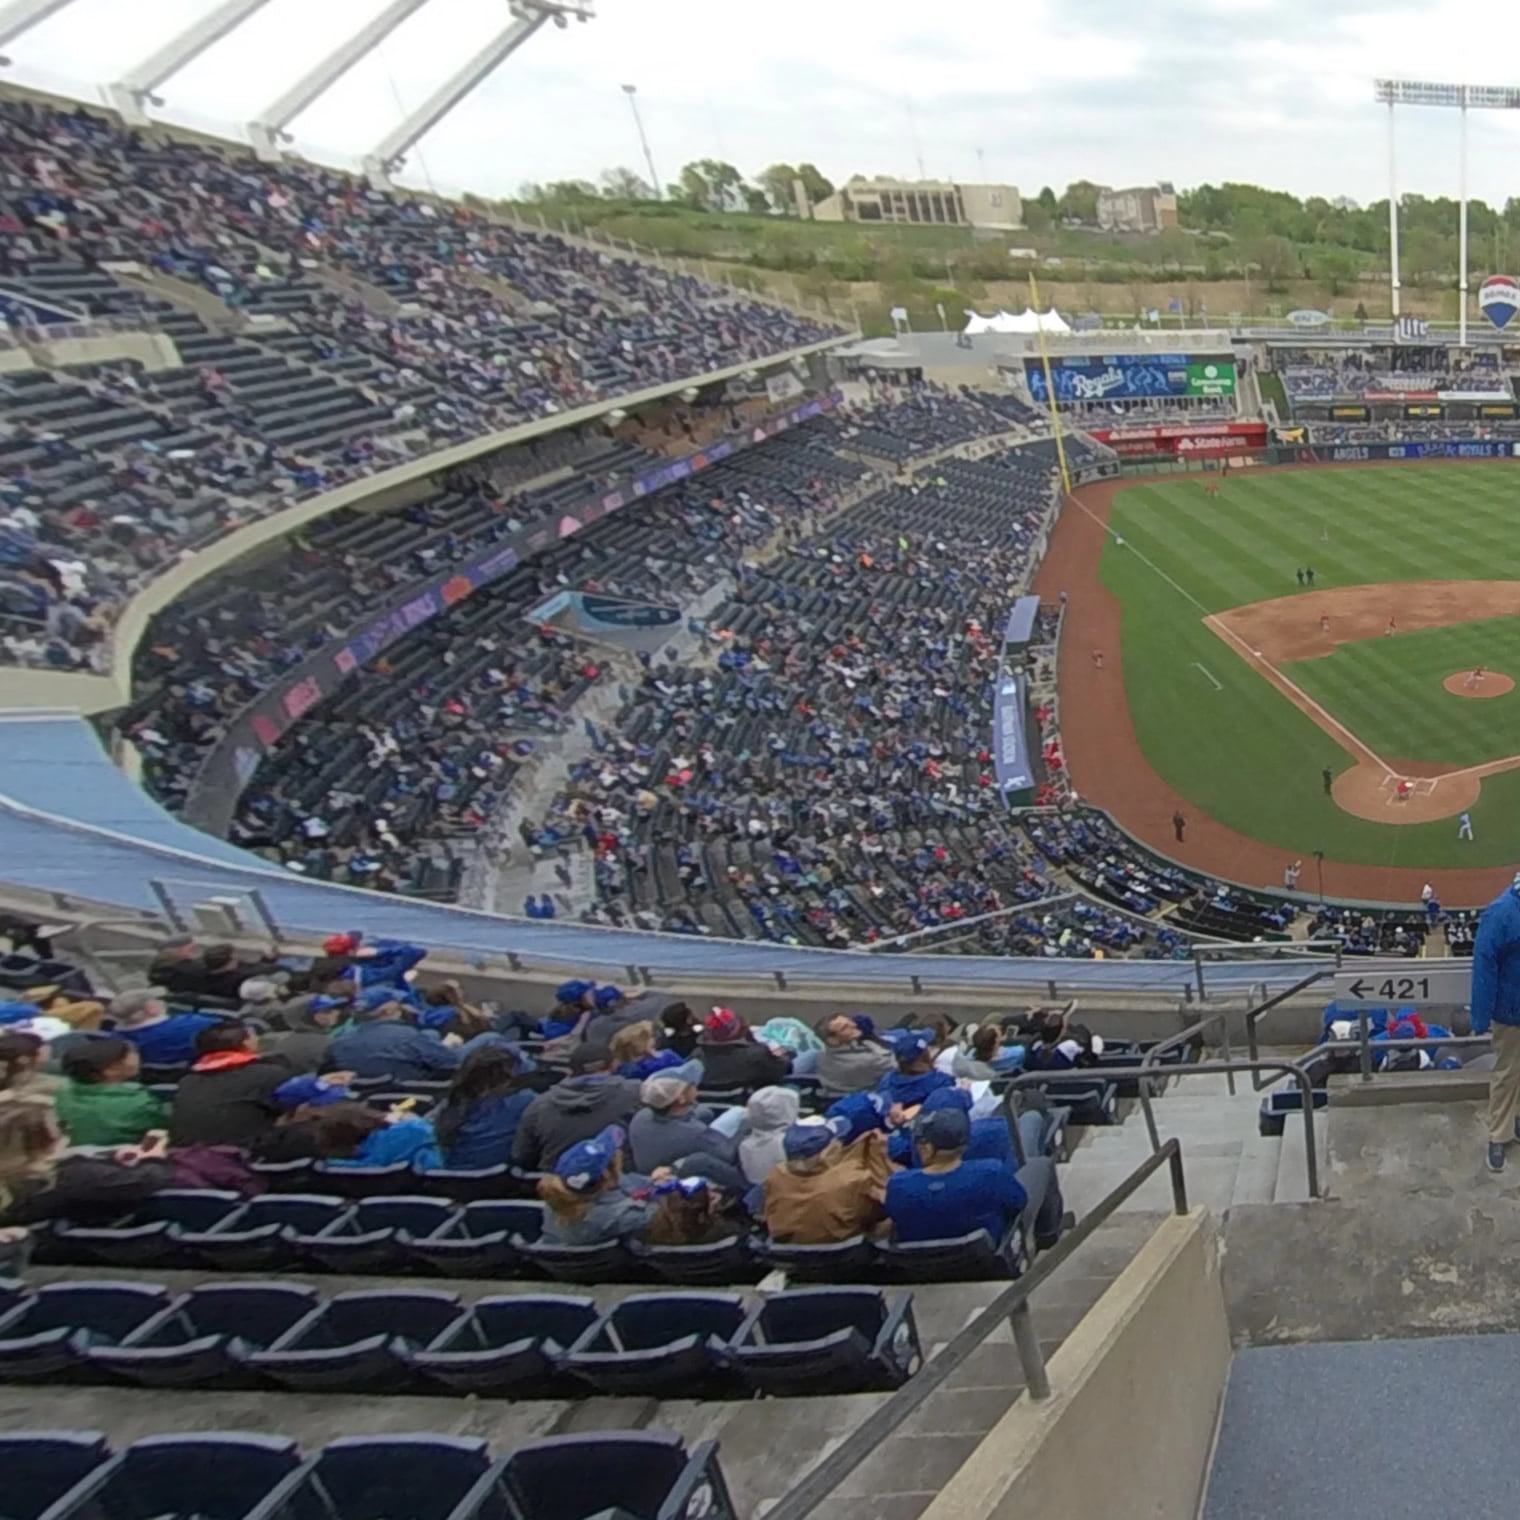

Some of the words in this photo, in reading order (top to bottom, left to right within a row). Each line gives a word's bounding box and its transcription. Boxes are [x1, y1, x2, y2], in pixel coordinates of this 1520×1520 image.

[1072, 367, 1125, 398] Royals
[1333, 446, 1369, 459] ANGELS
[1459, 444, 1491, 457] ROYALS
[1379, 977, 1429, 999] 421
